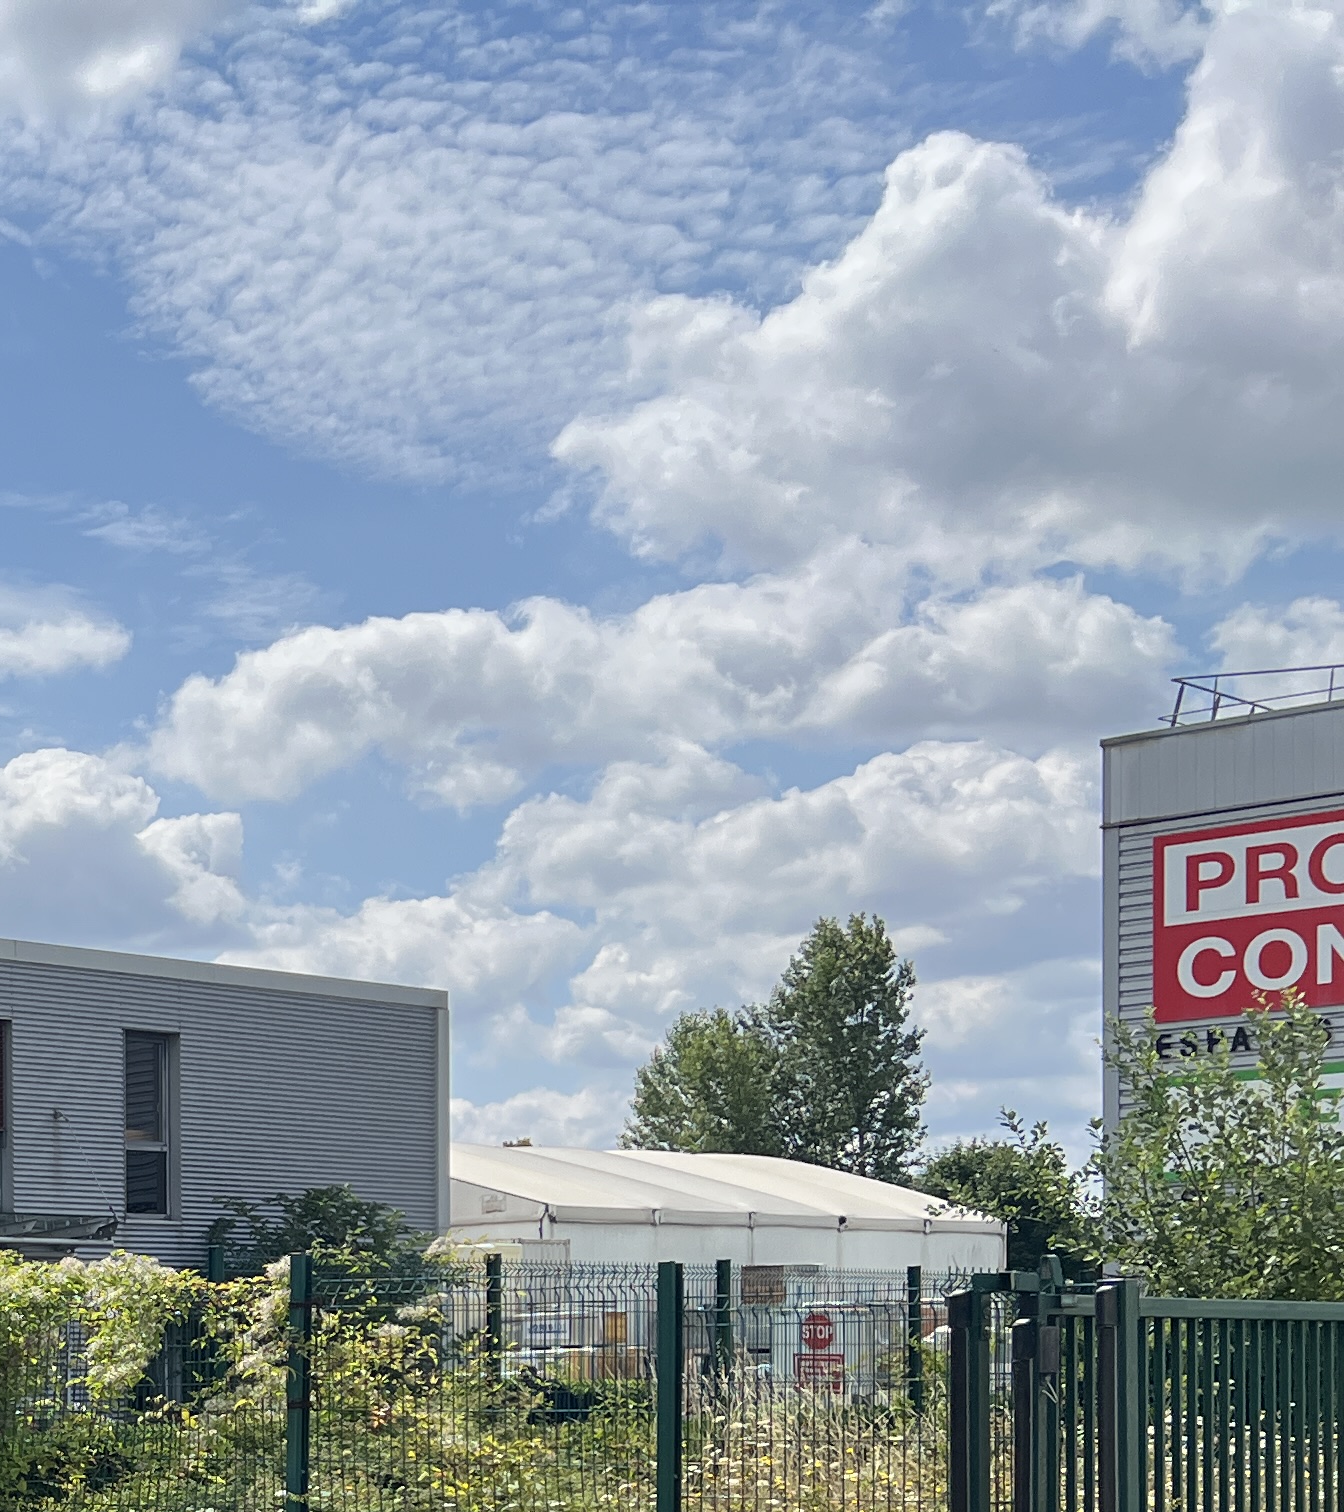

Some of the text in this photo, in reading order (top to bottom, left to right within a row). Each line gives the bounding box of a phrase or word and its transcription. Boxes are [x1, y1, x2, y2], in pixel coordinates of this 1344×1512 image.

[1185, 832, 1344, 912] PRO
[1156, 1017, 1333, 1059] ESPA
[802, 1325, 832, 1339] STOP
